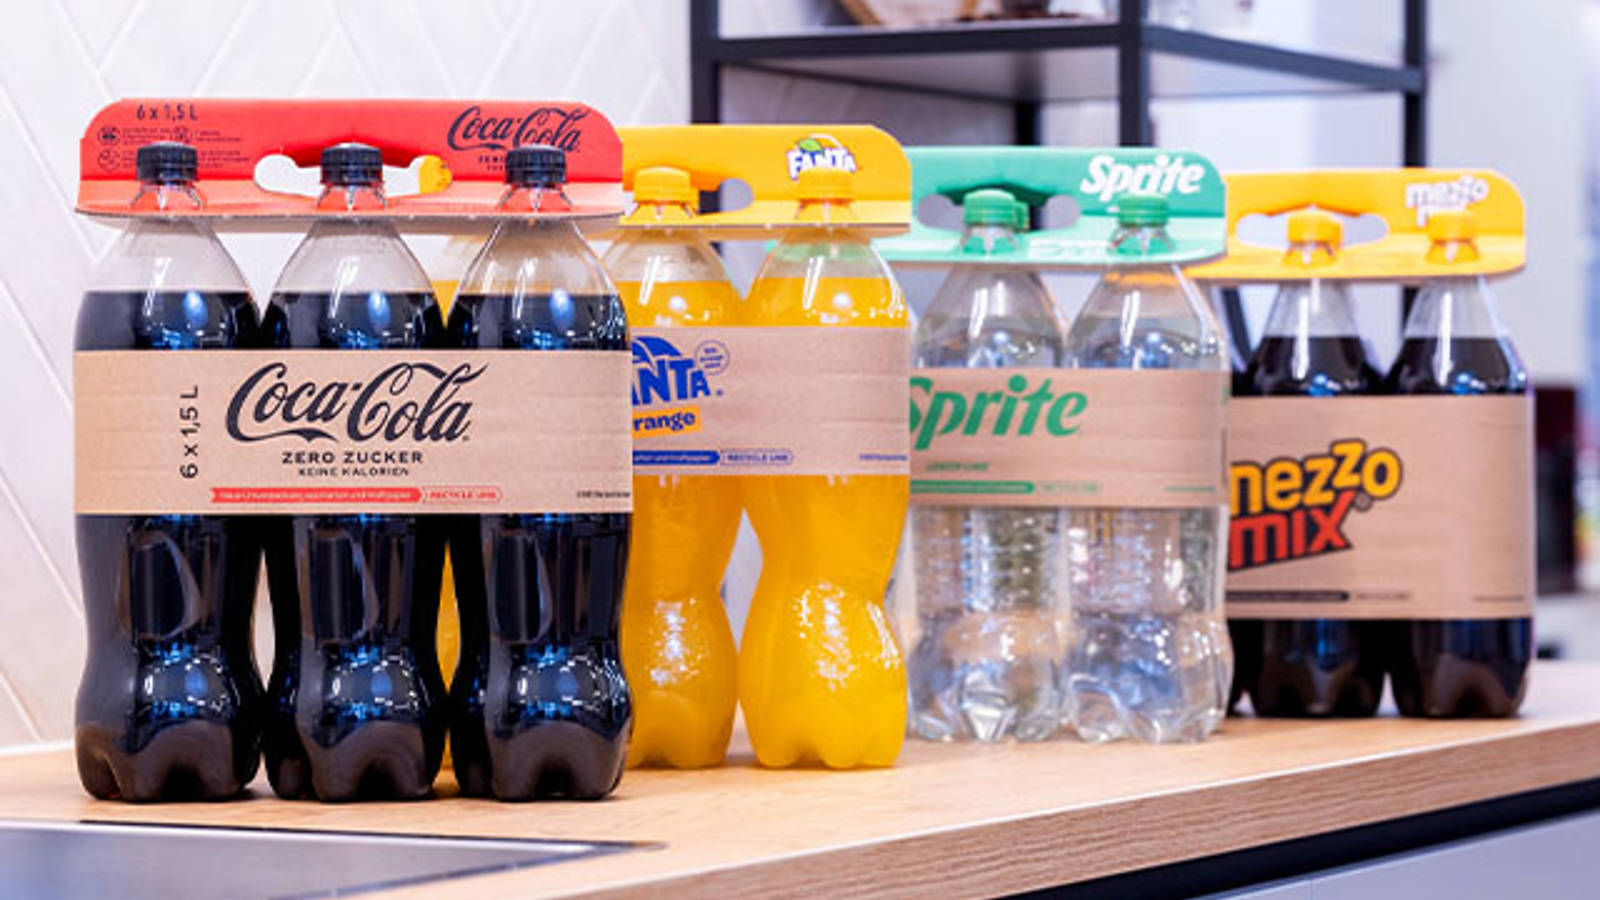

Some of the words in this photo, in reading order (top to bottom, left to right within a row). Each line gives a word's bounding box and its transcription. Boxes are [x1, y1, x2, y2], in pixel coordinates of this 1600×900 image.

[136, 103, 146, 120] 6
[149, 106, 158, 119] x
[163, 103, 185, 121] 1,5
[189, 103, 198, 120] L
[446, 105, 589, 152] Coca-Cola
[786, 147, 858, 181] FANTA
[1080, 154, 1205, 202] Sprite
[179, 385, 199, 399] L
[632, 357, 711, 405] NTA
[225, 361, 490, 443] Coca-Cola
[179, 407, 201, 438] 1,5
[632, 412, 696, 432] range
[183, 444, 199, 457] x
[281, 451, 336, 464] ZERO
[343, 451, 424, 464] ZUCKER
[179, 464, 199, 479] 6
[298, 467, 338, 477] KEINE
[341, 467, 410, 477] KALORIEN
[1229, 489, 1353, 570] mix
